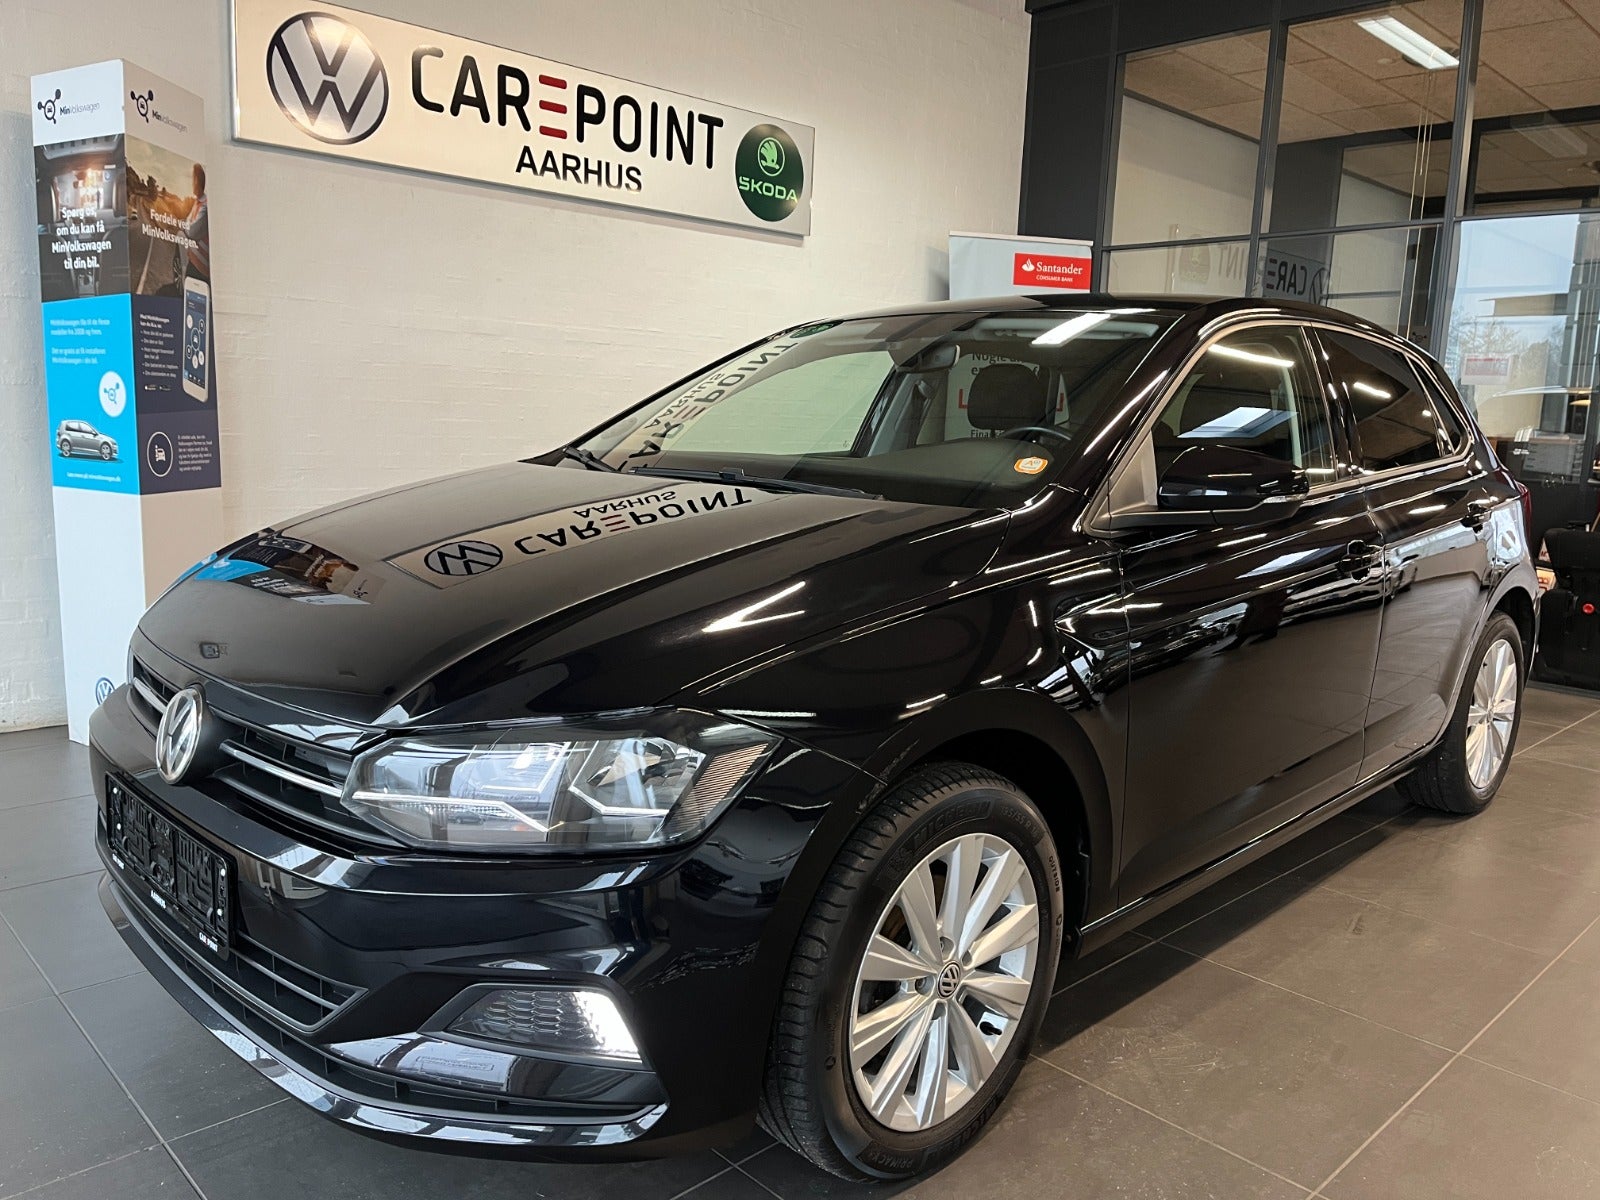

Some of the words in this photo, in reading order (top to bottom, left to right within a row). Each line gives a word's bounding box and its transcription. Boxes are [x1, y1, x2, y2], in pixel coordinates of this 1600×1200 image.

[59, 101, 101, 116] MinVolkswagen
[411, 45, 724, 170] CAREPOINT
[515, 145, 643, 194] AARHUS
[56, 226, 69, 236] om
[69, 222, 80, 235] du
[80, 221, 96, 234] kan
[96, 219, 106, 233] få
[150, 208, 177, 227] Fordele
[177, 218, 191, 231] ved
[141, 223, 199, 249] MinVolkswagen.
[51, 240, 112, 253] MinVolkswagen
[63, 257, 73, 270] til
[73, 256, 87, 270] din
[86, 255, 100, 269] bil.
[1036, 261, 1084, 275] Santander
[1036, 274, 1061, 282] CONSUMER
